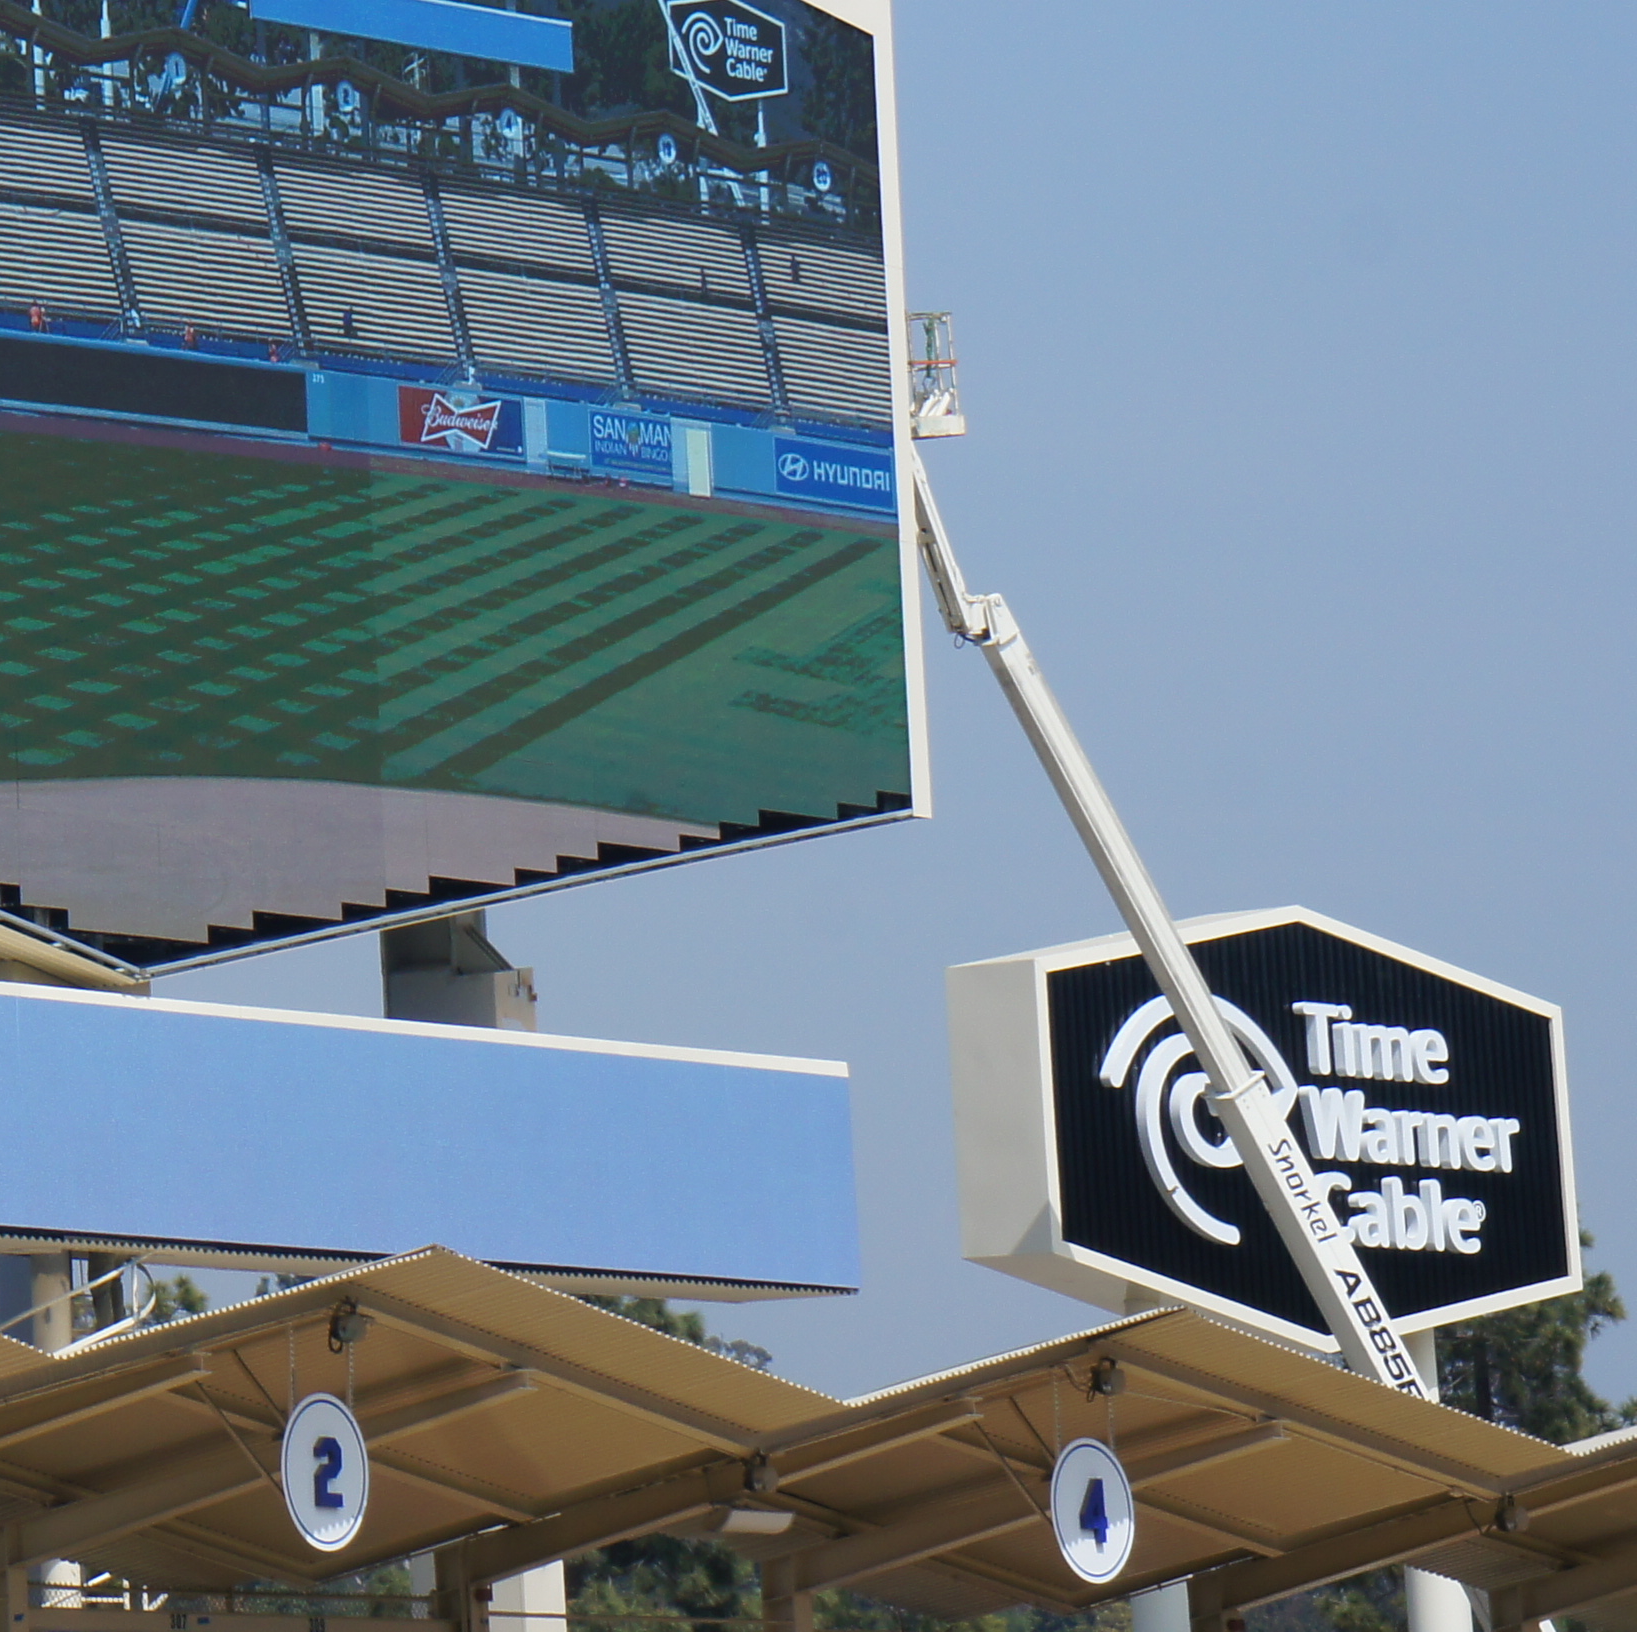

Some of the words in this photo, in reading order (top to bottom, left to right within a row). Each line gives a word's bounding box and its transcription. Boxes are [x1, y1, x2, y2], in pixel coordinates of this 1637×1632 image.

[724, 17, 758, 41] Time
[725, 37, 773, 63] Warner
[421, 404, 499, 431] Budweiser
[593, 414, 627, 442] SAN
[812, 459, 890, 492] HYUNDAI
[1292, 1001, 1449, 1085] Time
[1296, 1085, 1521, 1174] Warner
[1268, 1137, 1338, 1244] Snorkel
[313, 1436, 344, 1508] 2
[1079, 1478, 1109, 1544] 4
[170, 1613, 187, 1630] 307
